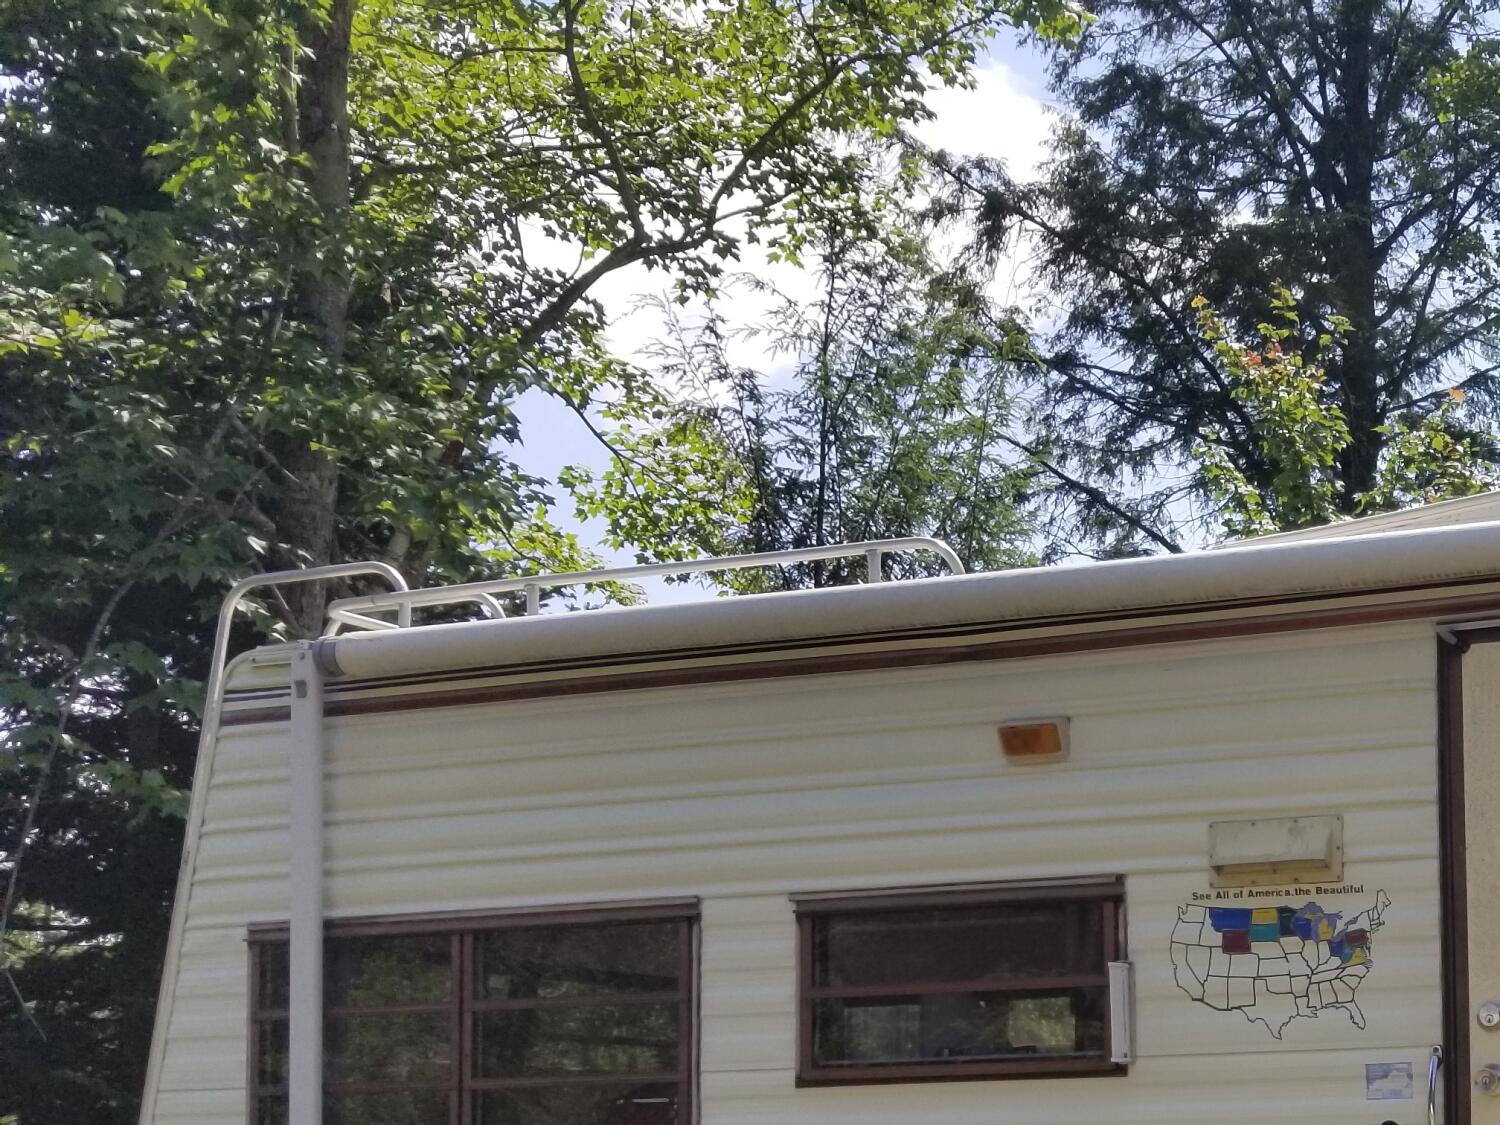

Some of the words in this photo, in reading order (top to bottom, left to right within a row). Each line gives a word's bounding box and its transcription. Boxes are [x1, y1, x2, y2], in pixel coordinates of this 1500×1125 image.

[1191, 891, 1212, 901] See
[1215, 889, 1230, 899] All
[1233, 889, 1244, 899] of
[1295, 886, 1312, 896] the
[1315, 884, 1364, 896] Beautiful
